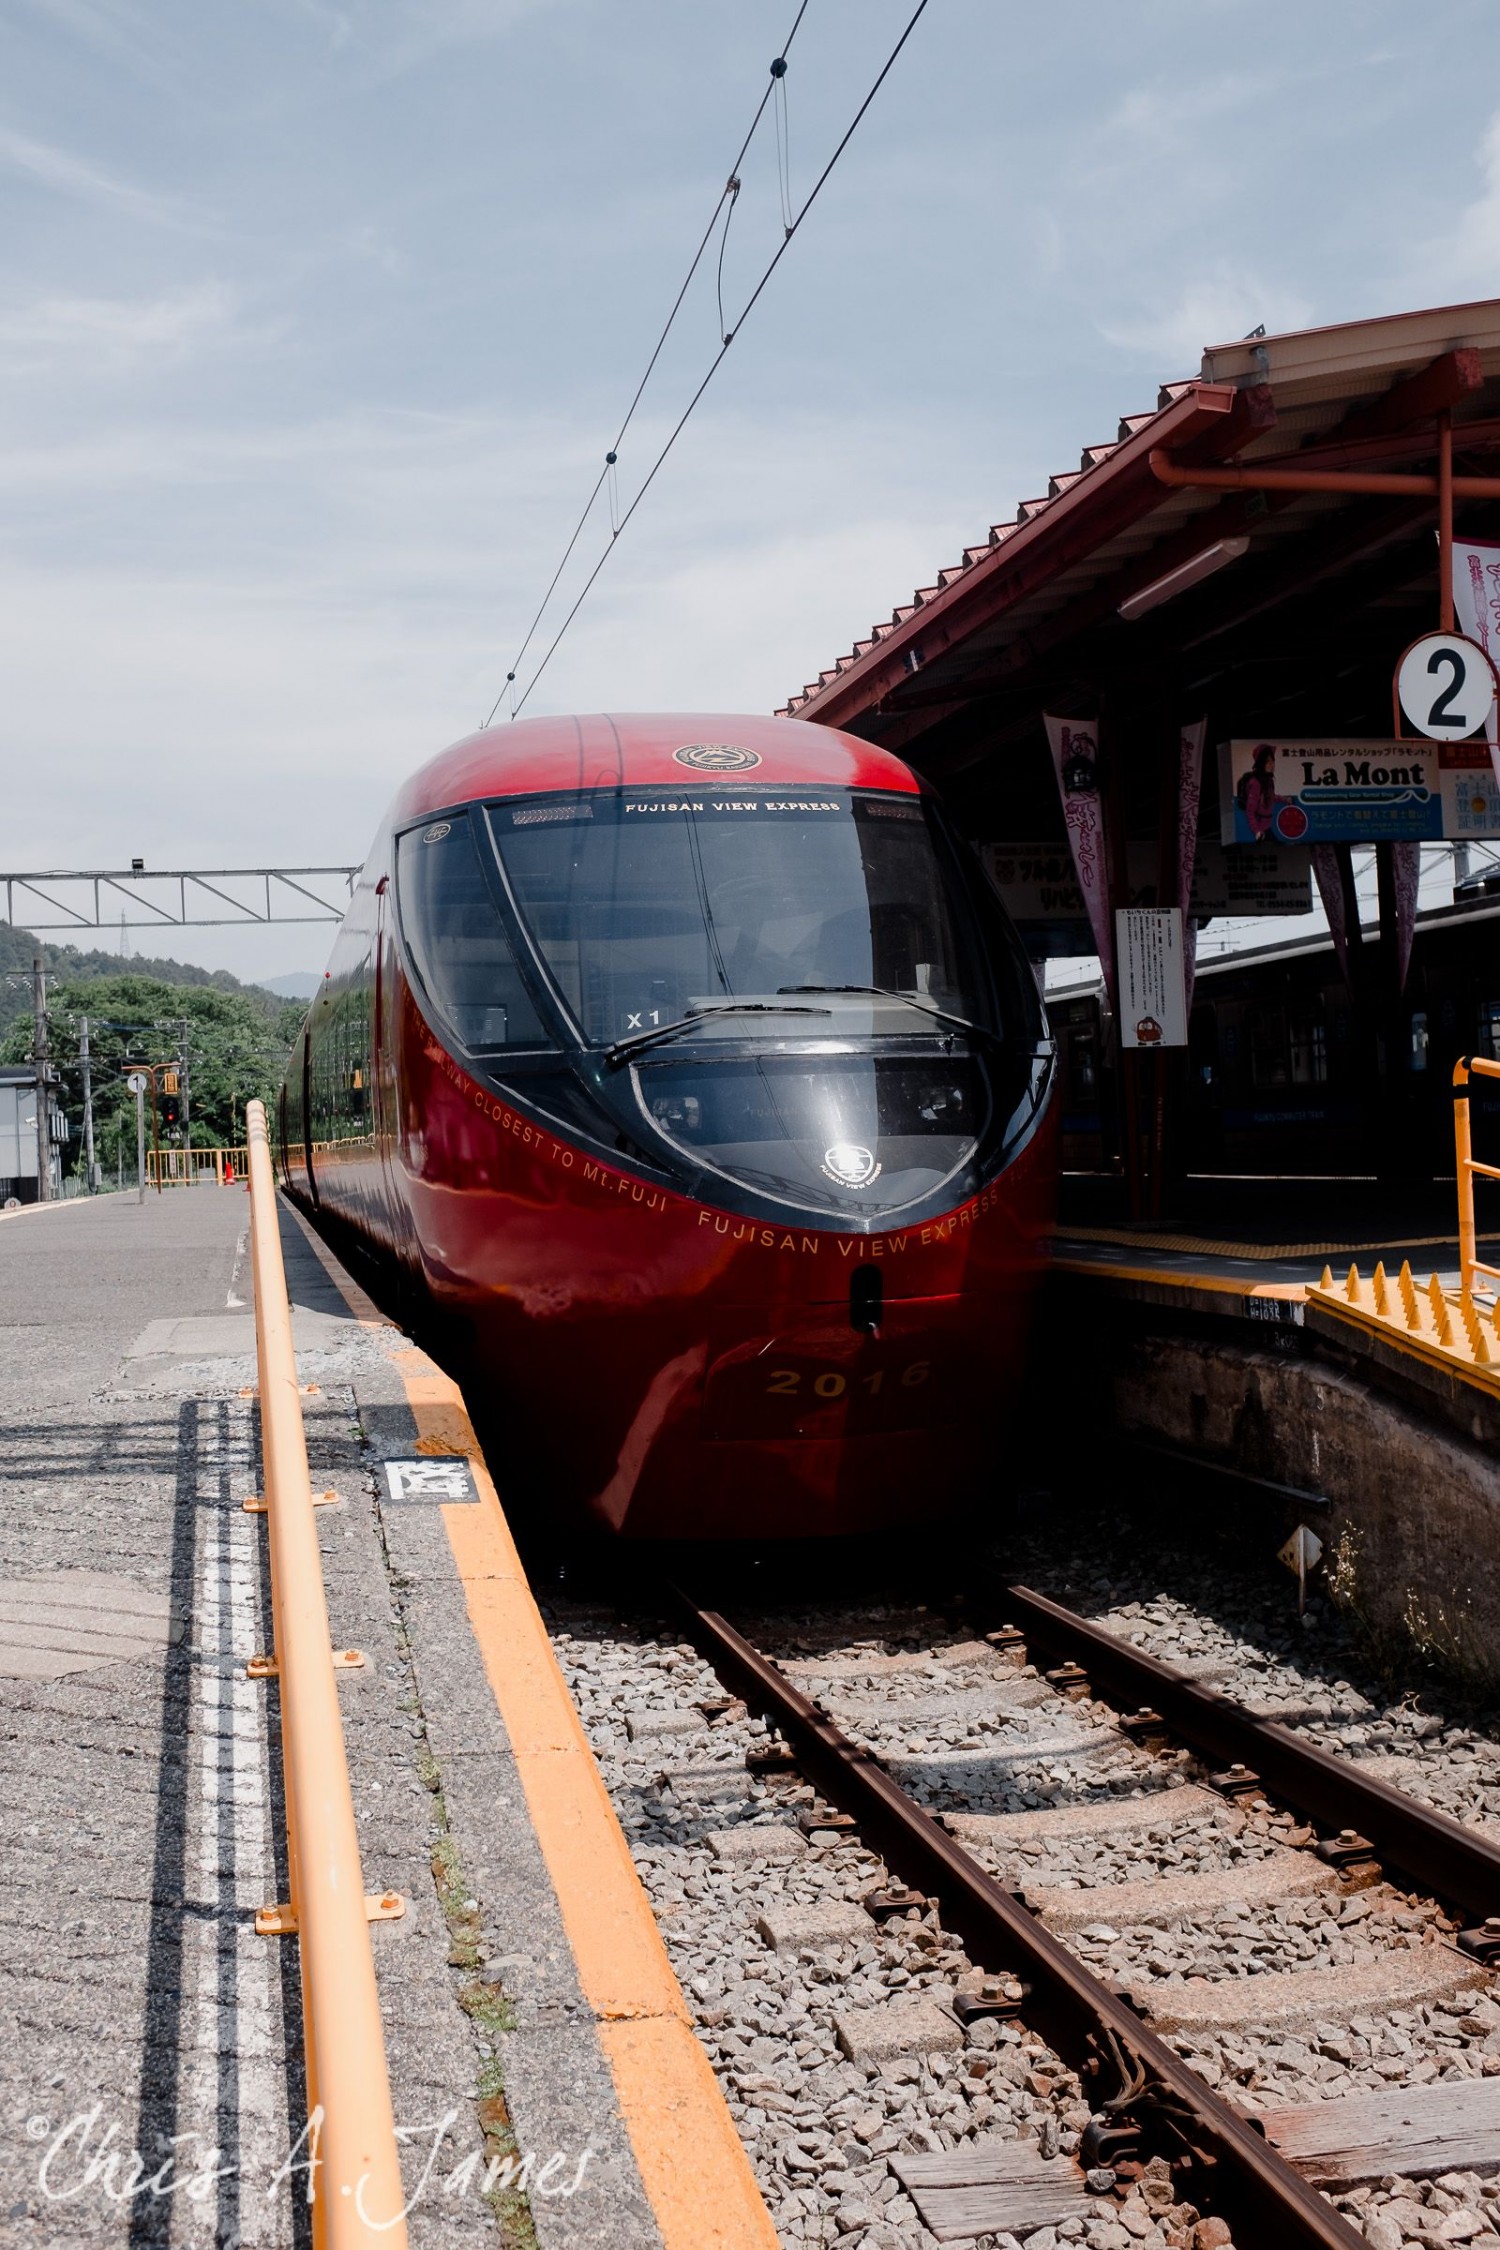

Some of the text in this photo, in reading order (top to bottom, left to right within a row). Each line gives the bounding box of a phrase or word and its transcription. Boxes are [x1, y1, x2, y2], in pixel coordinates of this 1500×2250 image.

[1426, 648, 1467, 728] 2
[1302, 761, 1425, 786] La Mont
[625, 802, 841, 813] FUJISAN VIEW EXPRESS
[474, 1091, 544, 1148] CLOSEST
[552, 1143, 574, 1168] TO
[698, 1192, 999, 1258] FUJISAN VIEW EXPRESS
[766, 1360, 931, 1398] 2016
